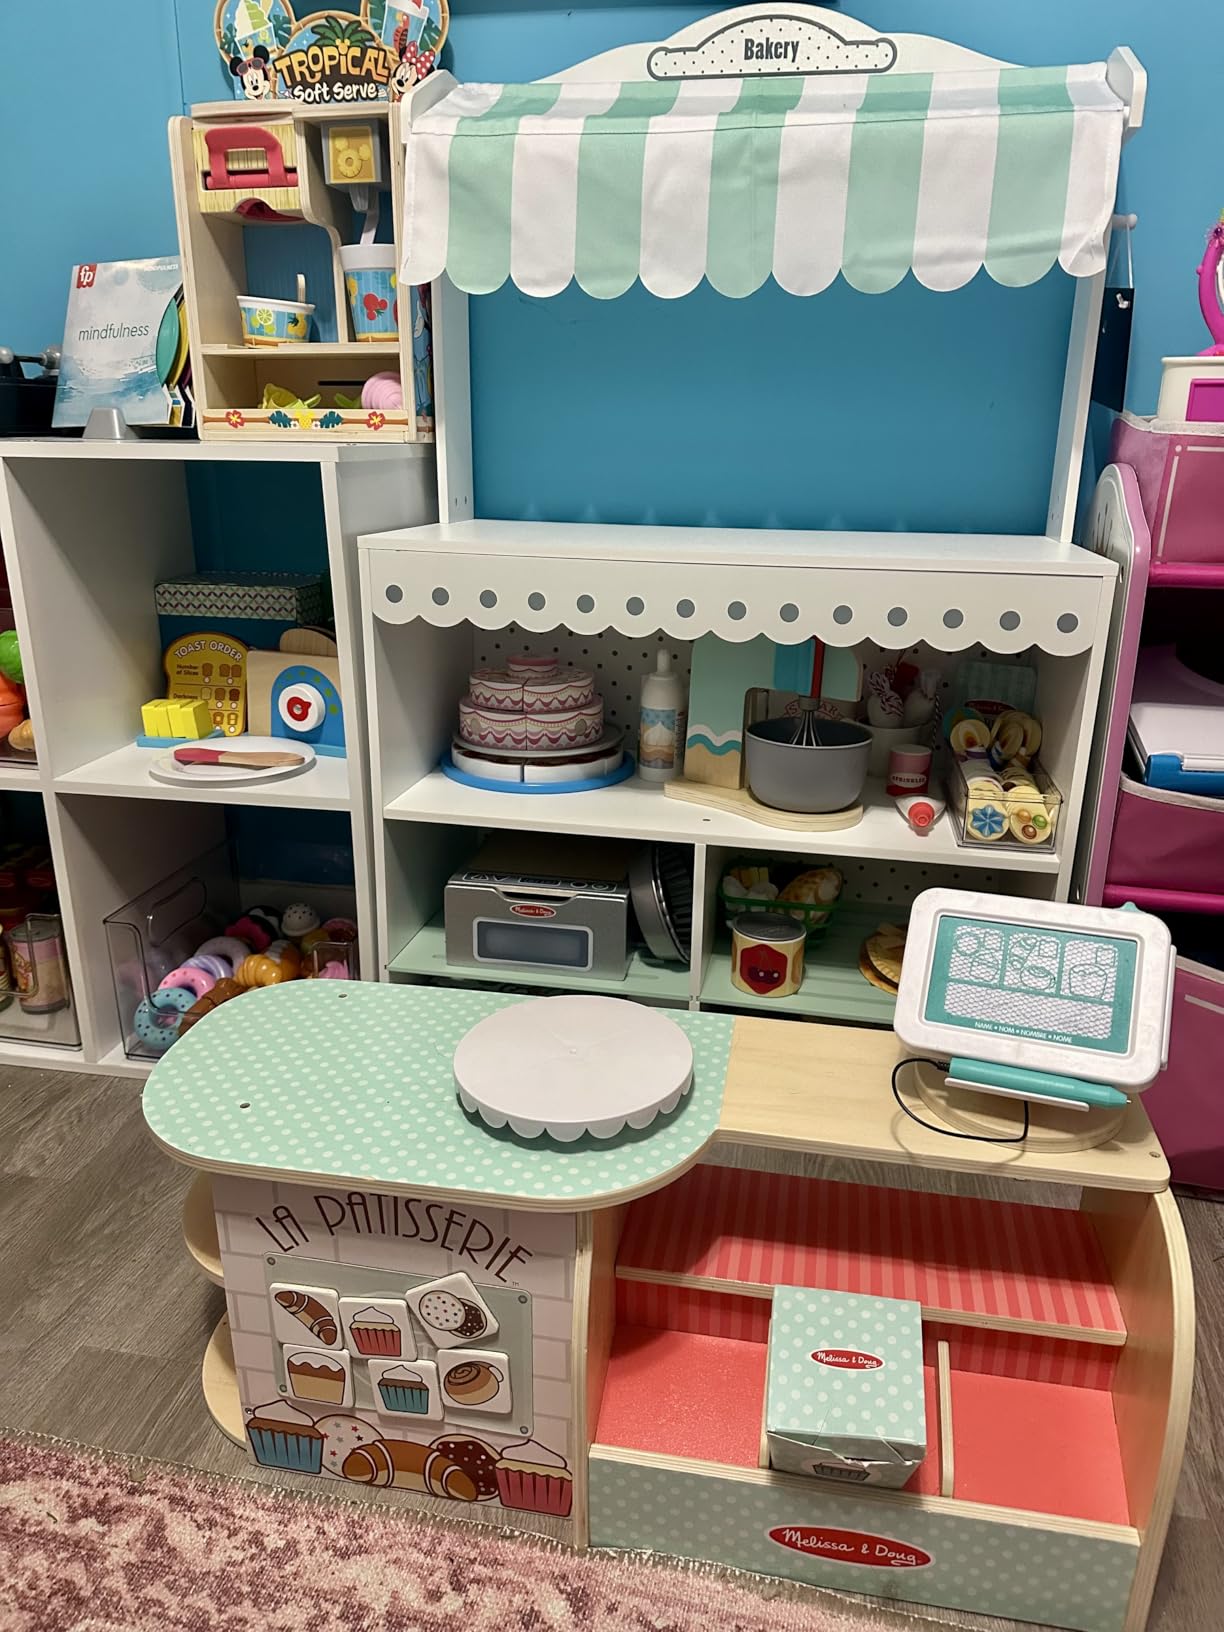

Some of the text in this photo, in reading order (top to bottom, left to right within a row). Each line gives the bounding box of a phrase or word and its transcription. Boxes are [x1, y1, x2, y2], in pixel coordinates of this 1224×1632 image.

[744, 37, 799, 63] Bakery
[293, 82, 377, 102] Soft Serve
[80, 266, 94, 285] fp
[79, 323, 149, 341] mindfulness
[175, 641, 242, 661] TOAST ORDER
[974, 1022, 1073, 1044] NAME NOM NOMBRE NOME
[255, 1191, 534, 1283] LA PATISSERIE
[817, 1351, 850, 1363] Melissa
[858, 1356, 878, 1369] Doug
[782, 1528, 916, 1565] Melissa & Doug
